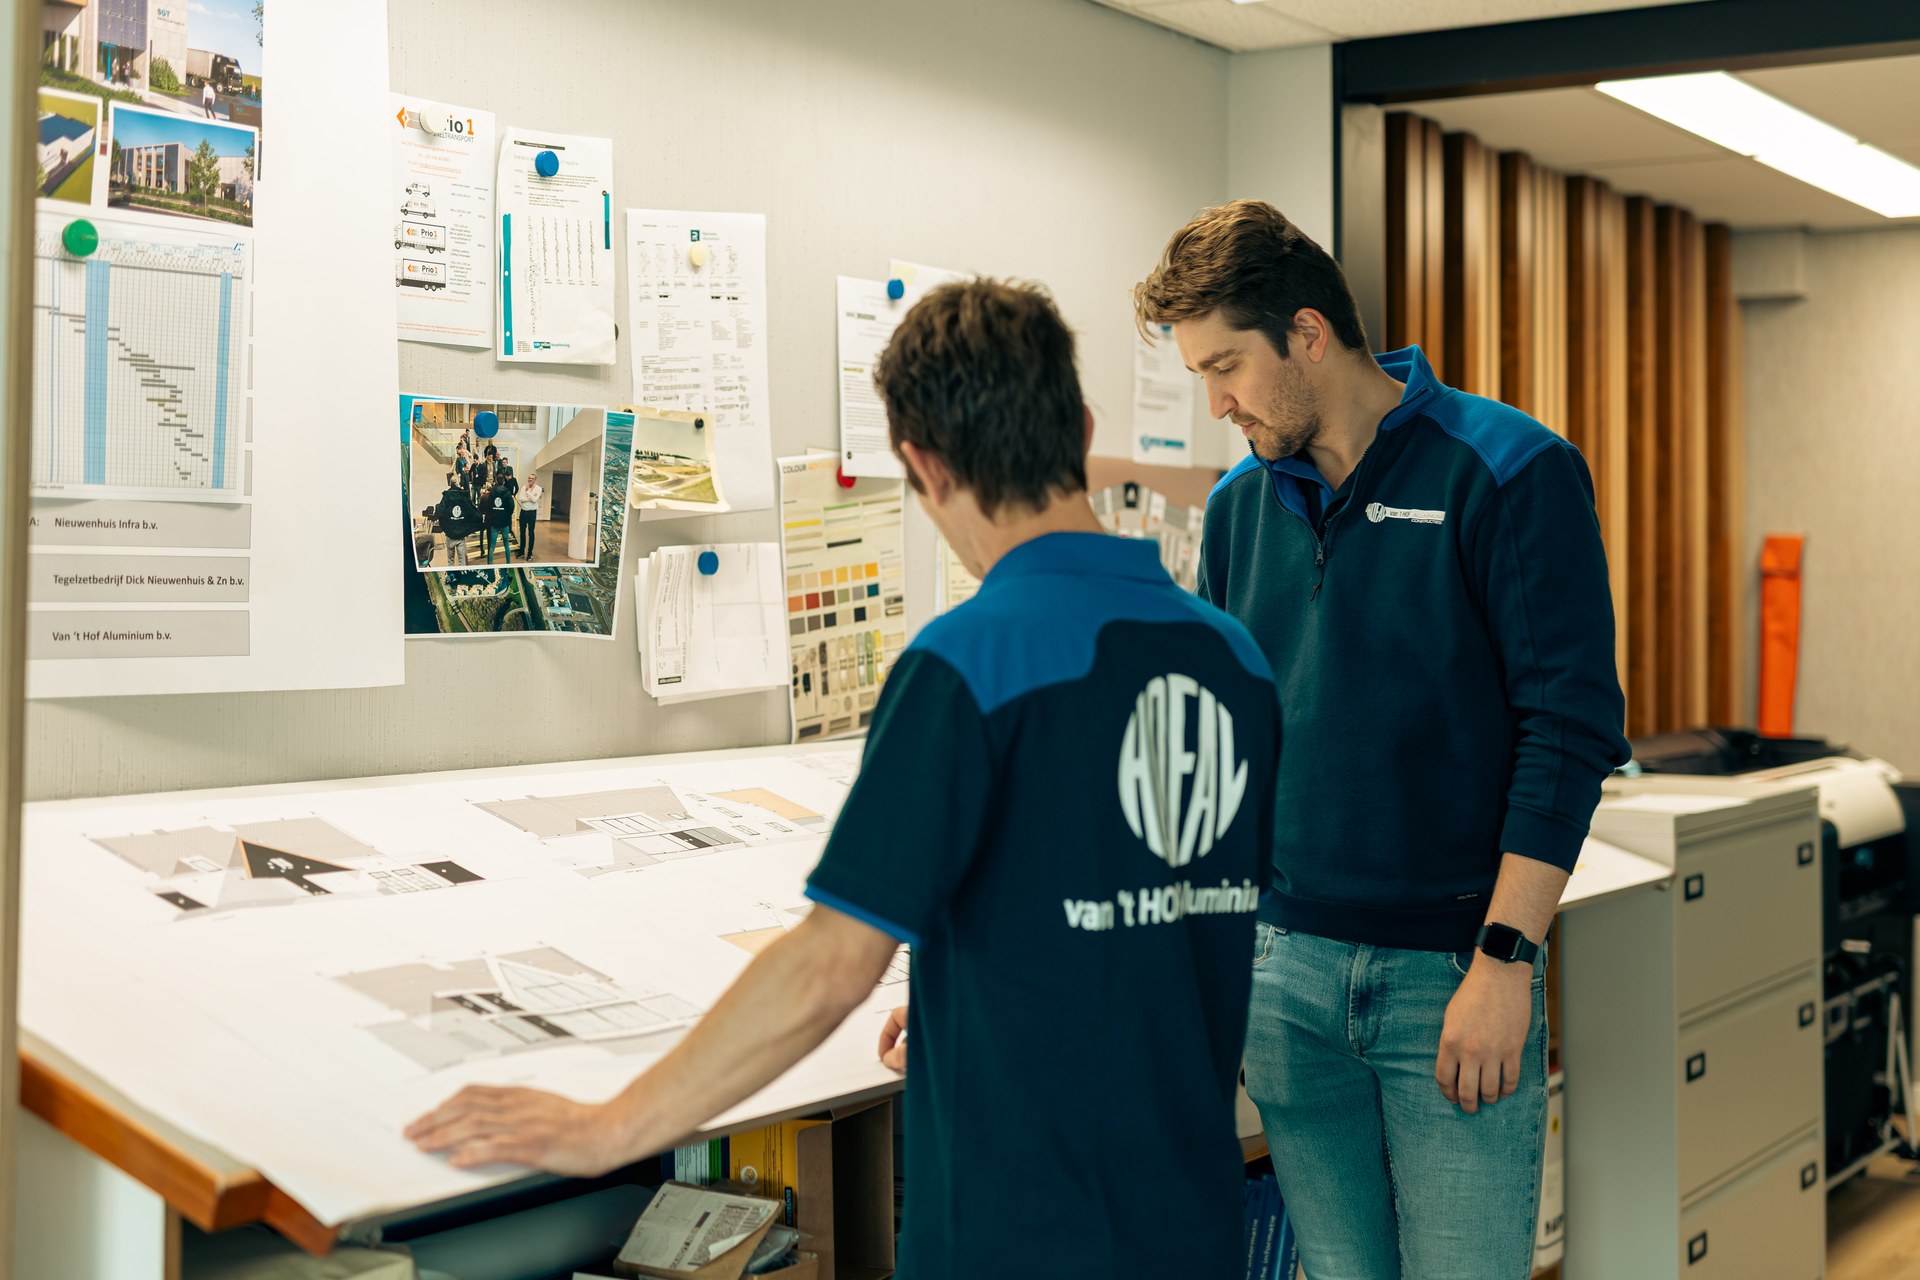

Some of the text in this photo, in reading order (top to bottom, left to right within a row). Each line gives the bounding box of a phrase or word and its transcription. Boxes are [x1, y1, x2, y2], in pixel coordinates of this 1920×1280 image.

[783, 464, 806, 474] COLOUR
[54, 517, 117, 529] Nieuwenhuis
[119, 519, 140, 529] Infra
[143, 520, 158, 530] b.v.
[53, 574, 245, 587] Tegelzetbedrijf Dick Nieuwenhuis & Zn b.v.
[52, 632, 70, 641] Van
[83, 631, 101, 641] Hof
[102, 631, 154, 641] Aluminium
[156, 631, 172, 641] b.v.
[1063, 899, 1114, 931] van
